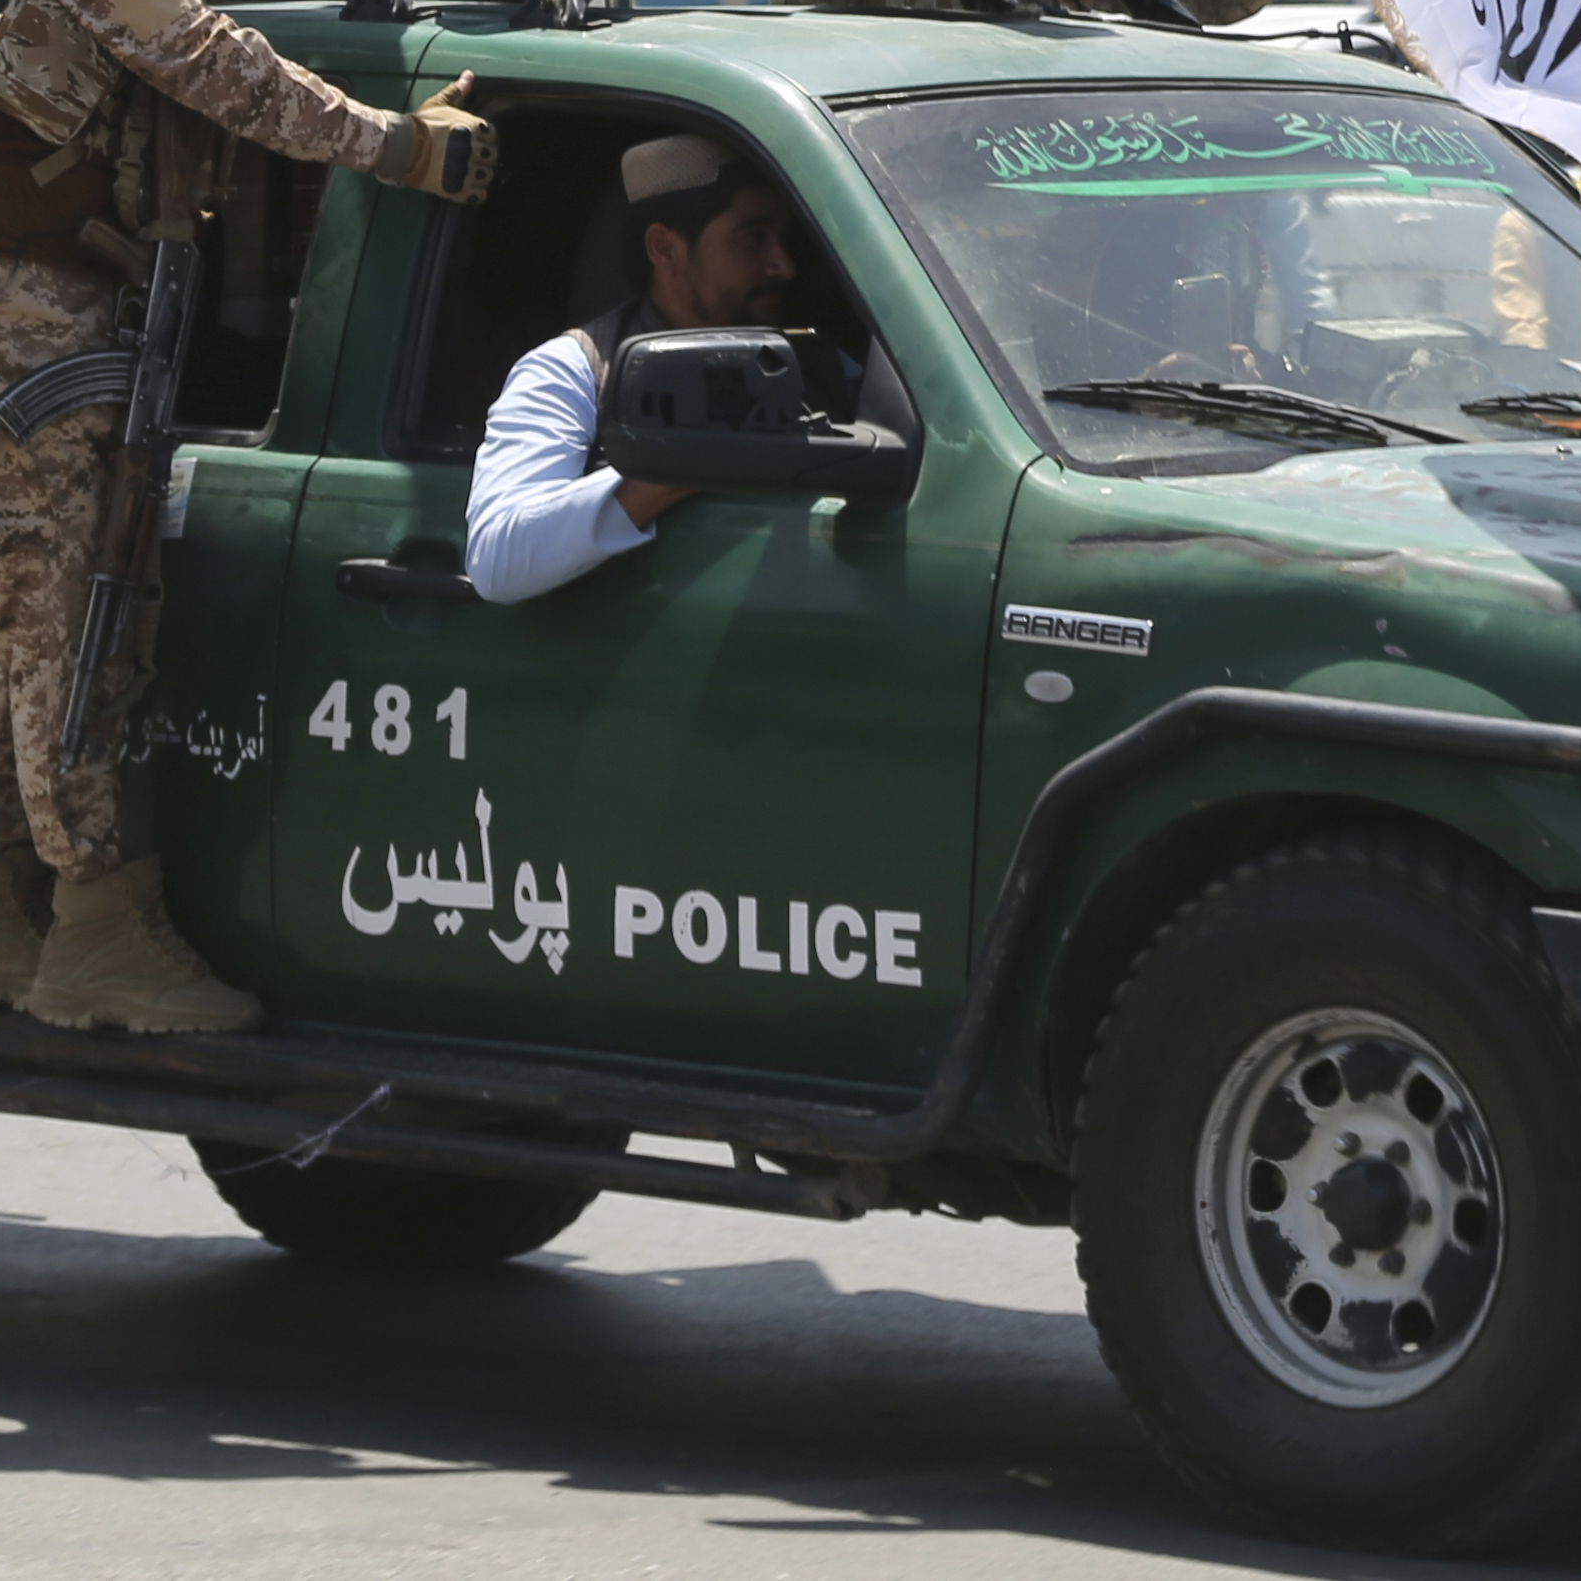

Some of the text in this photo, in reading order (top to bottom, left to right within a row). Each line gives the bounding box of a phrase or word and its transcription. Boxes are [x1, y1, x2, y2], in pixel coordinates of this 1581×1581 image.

[1007, 612, 1147, 650] RANGER
[308, 678, 468, 761] 481
[340, 786, 571, 976] پولیس
[614, 885, 923, 988] POLICE
